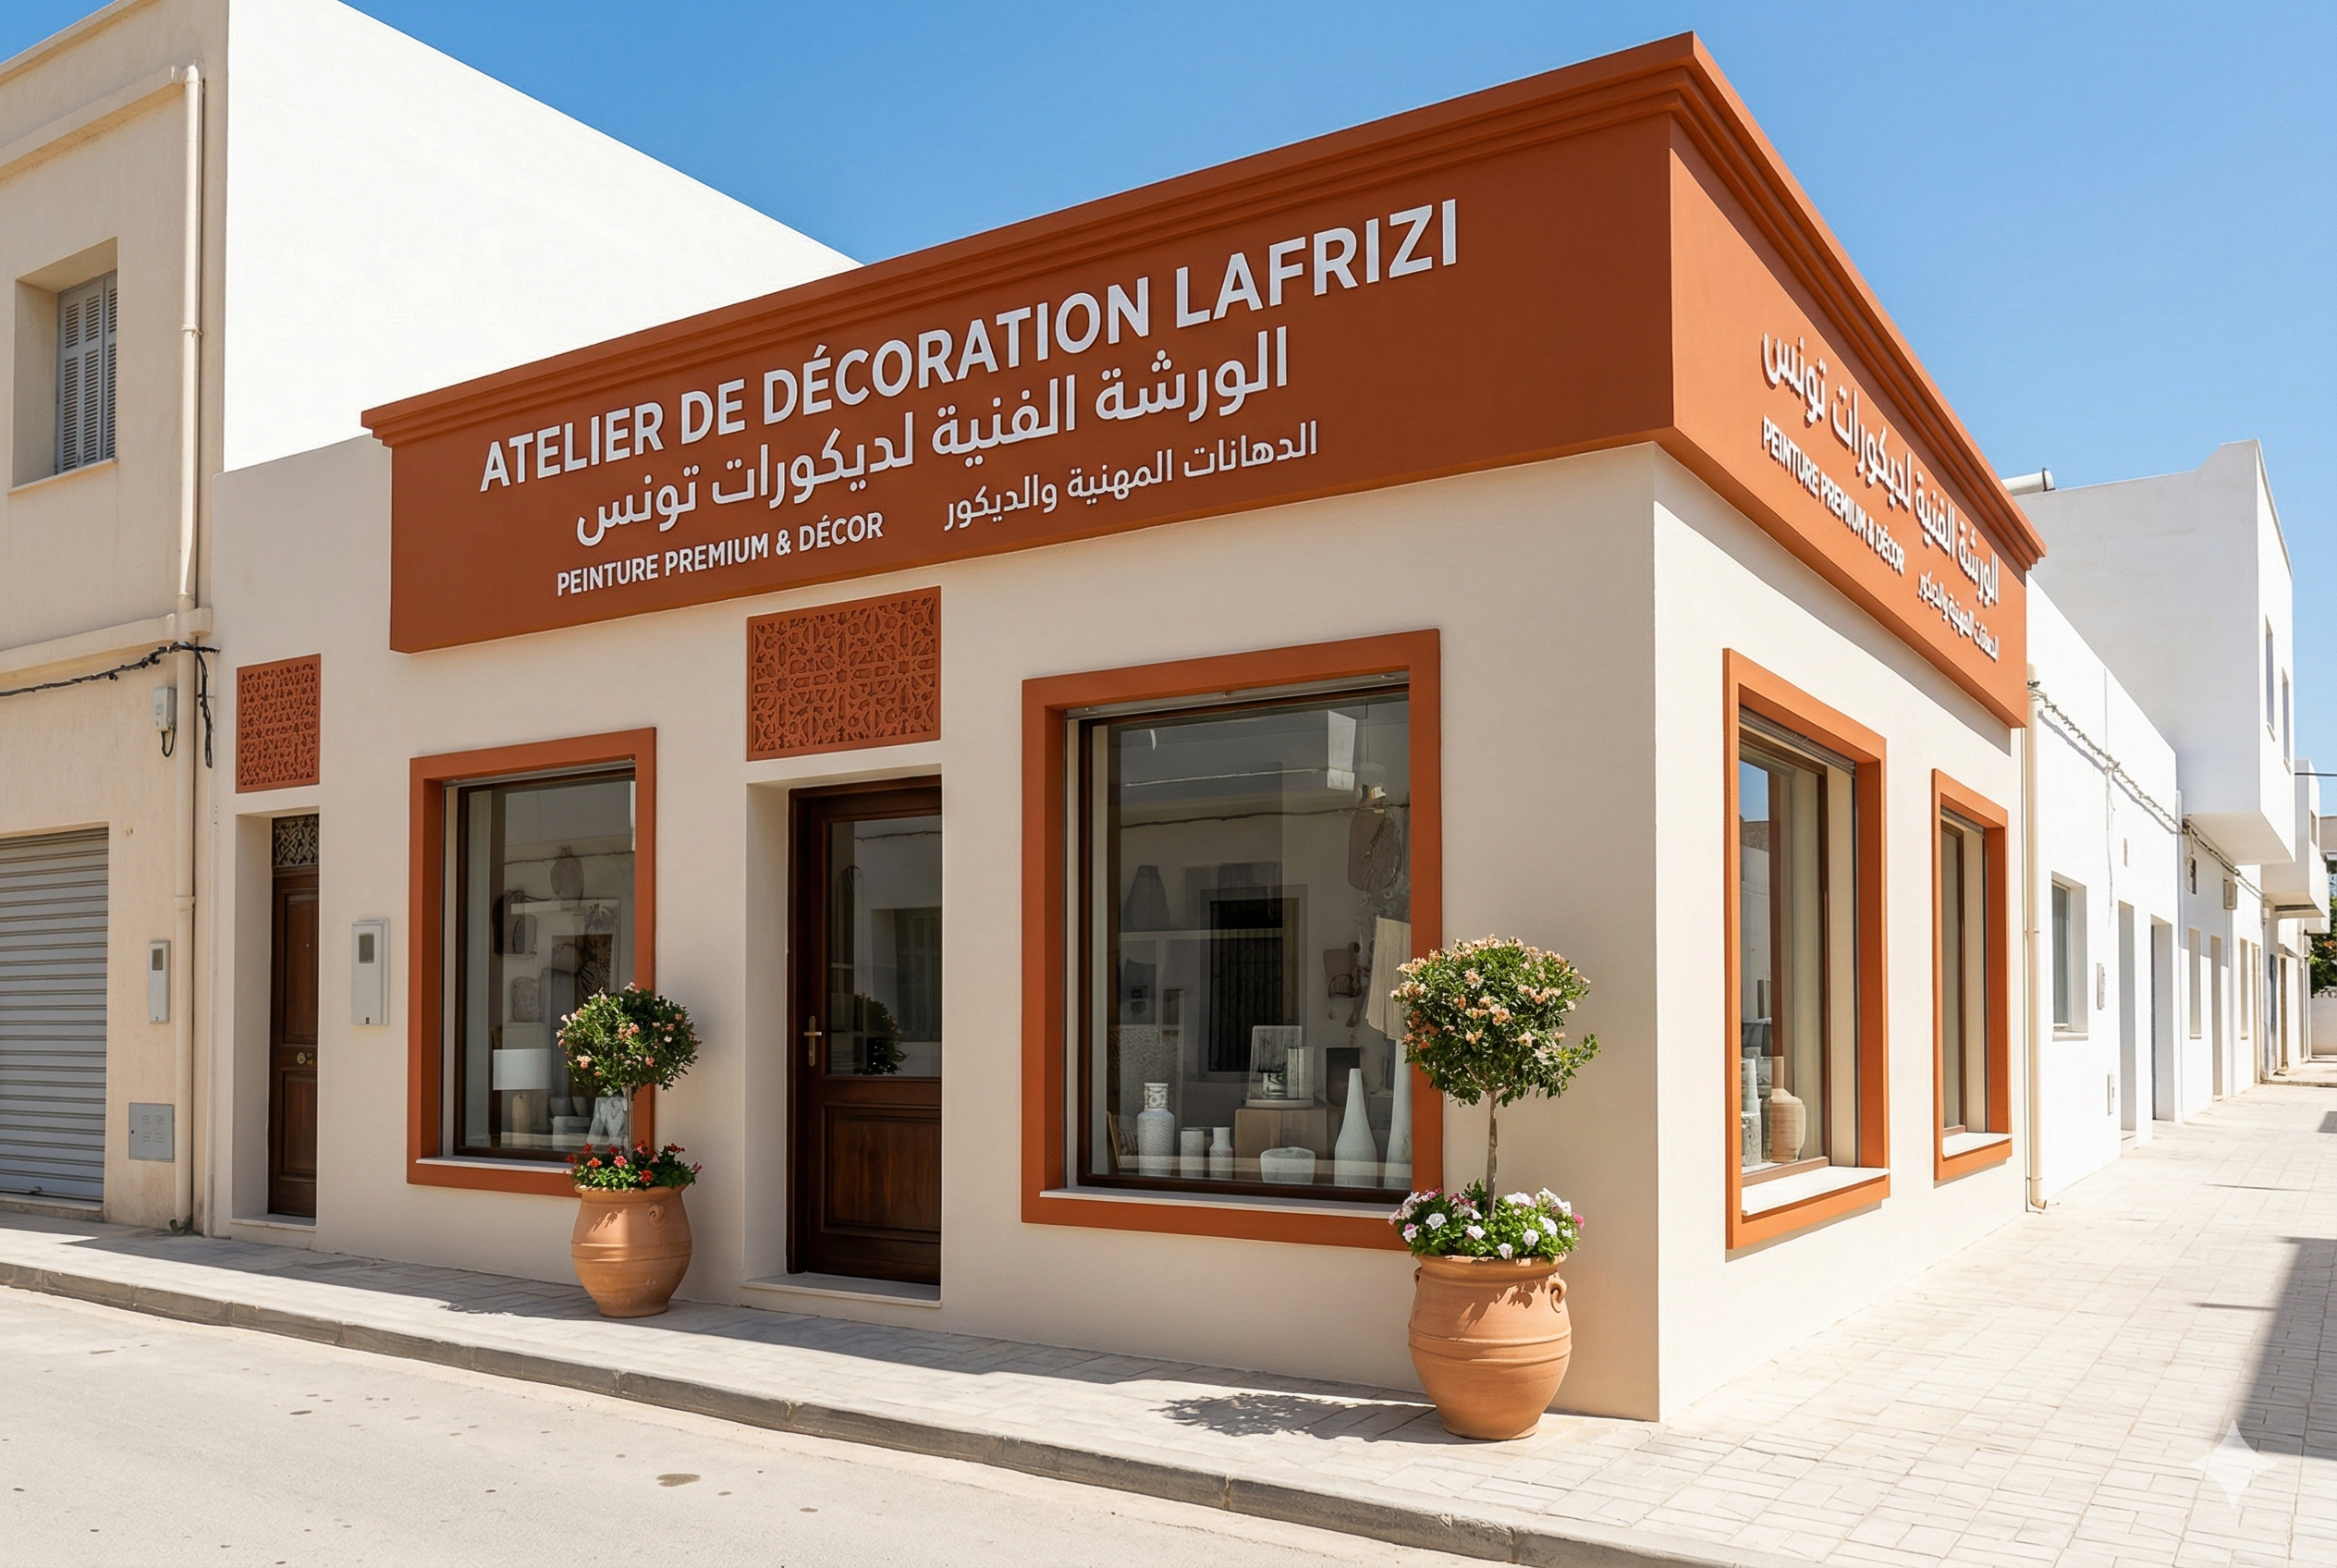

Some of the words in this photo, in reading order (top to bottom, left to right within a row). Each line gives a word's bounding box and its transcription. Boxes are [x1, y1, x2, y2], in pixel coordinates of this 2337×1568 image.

[479, 401, 665, 493] ATELIER
[680, 378, 746, 445] DE
[764, 276, 1149, 425] DÉCORATION
[1176, 198, 1457, 329] LAFRIZI
[1095, 325, 1288, 423] الورشة
[1762, 332, 1828, 424] تونس
[712, 411, 913, 509] لديكورات
[932, 374, 1076, 468] الفنية
[1183, 420, 1317, 478] الدهانات
[1830, 385, 1912, 510] لديكورات
[576, 464, 700, 546] تونس
[944, 473, 1058, 532] والديكور
[1067, 448, 1173, 505] المهنية
[1762, 414, 1820, 497] PEINTURE
[1820, 470, 1867, 539] PREMIUM
[1875, 523, 1906, 575] DÉCOR
[557, 553, 659, 597] PEINTURE
[665, 533, 769, 577] PREMIUM
[775, 529, 793, 556] &
[799, 511, 884, 552] DÉCOR
